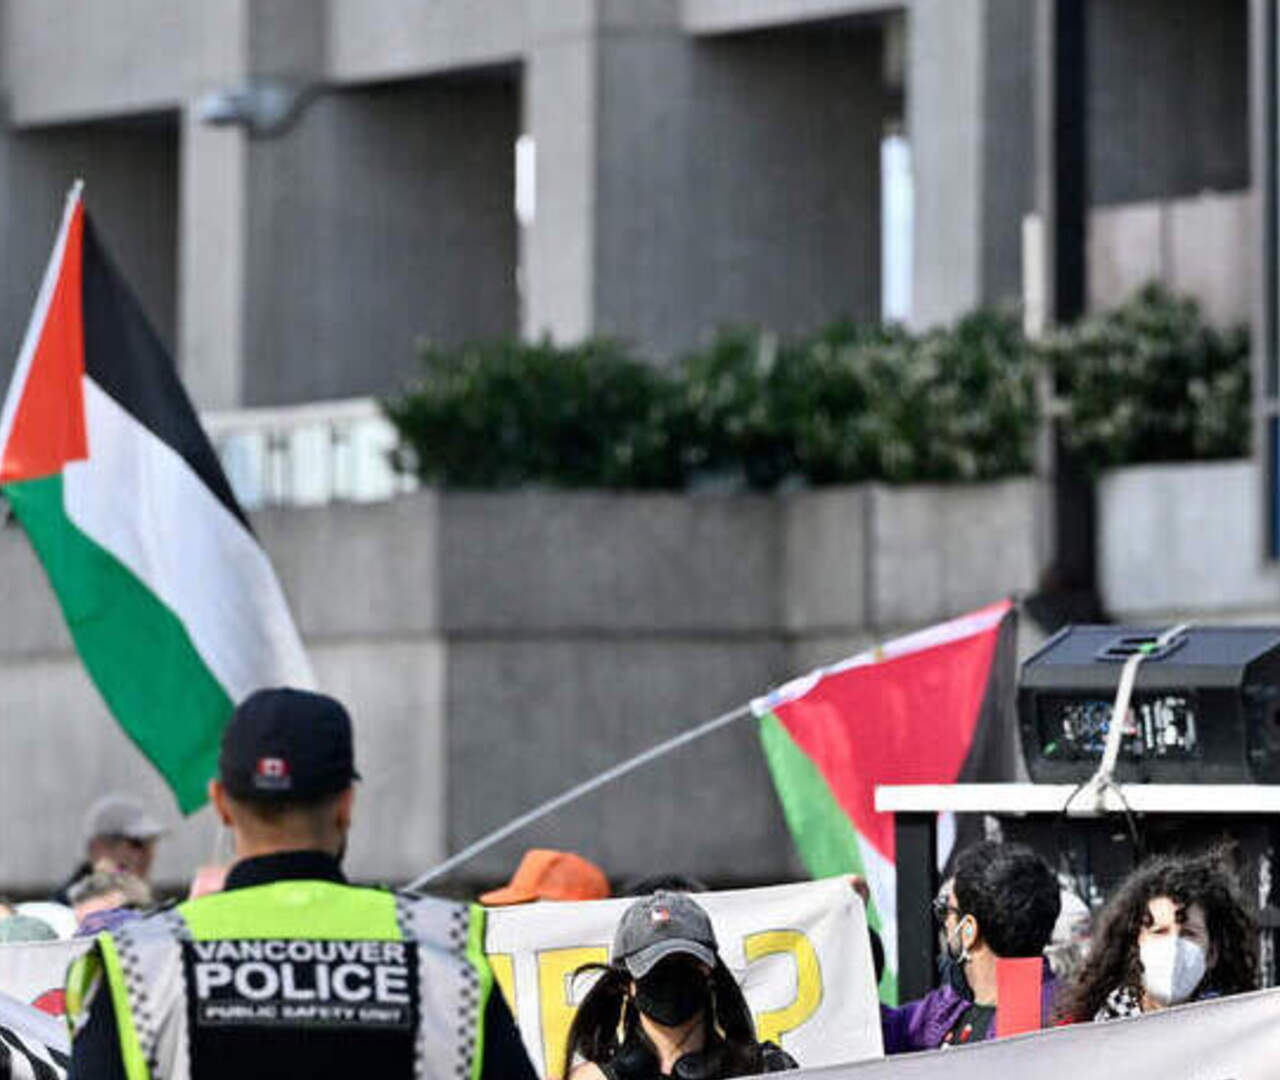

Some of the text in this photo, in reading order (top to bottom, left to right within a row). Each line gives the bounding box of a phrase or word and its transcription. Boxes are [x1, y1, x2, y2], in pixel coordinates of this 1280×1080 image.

[191, 939, 407, 963] VANCOUVER
[195, 962, 411, 1004] POLICE
[205, 1004, 402, 1021] PUBLIC SAFETY UNIT
